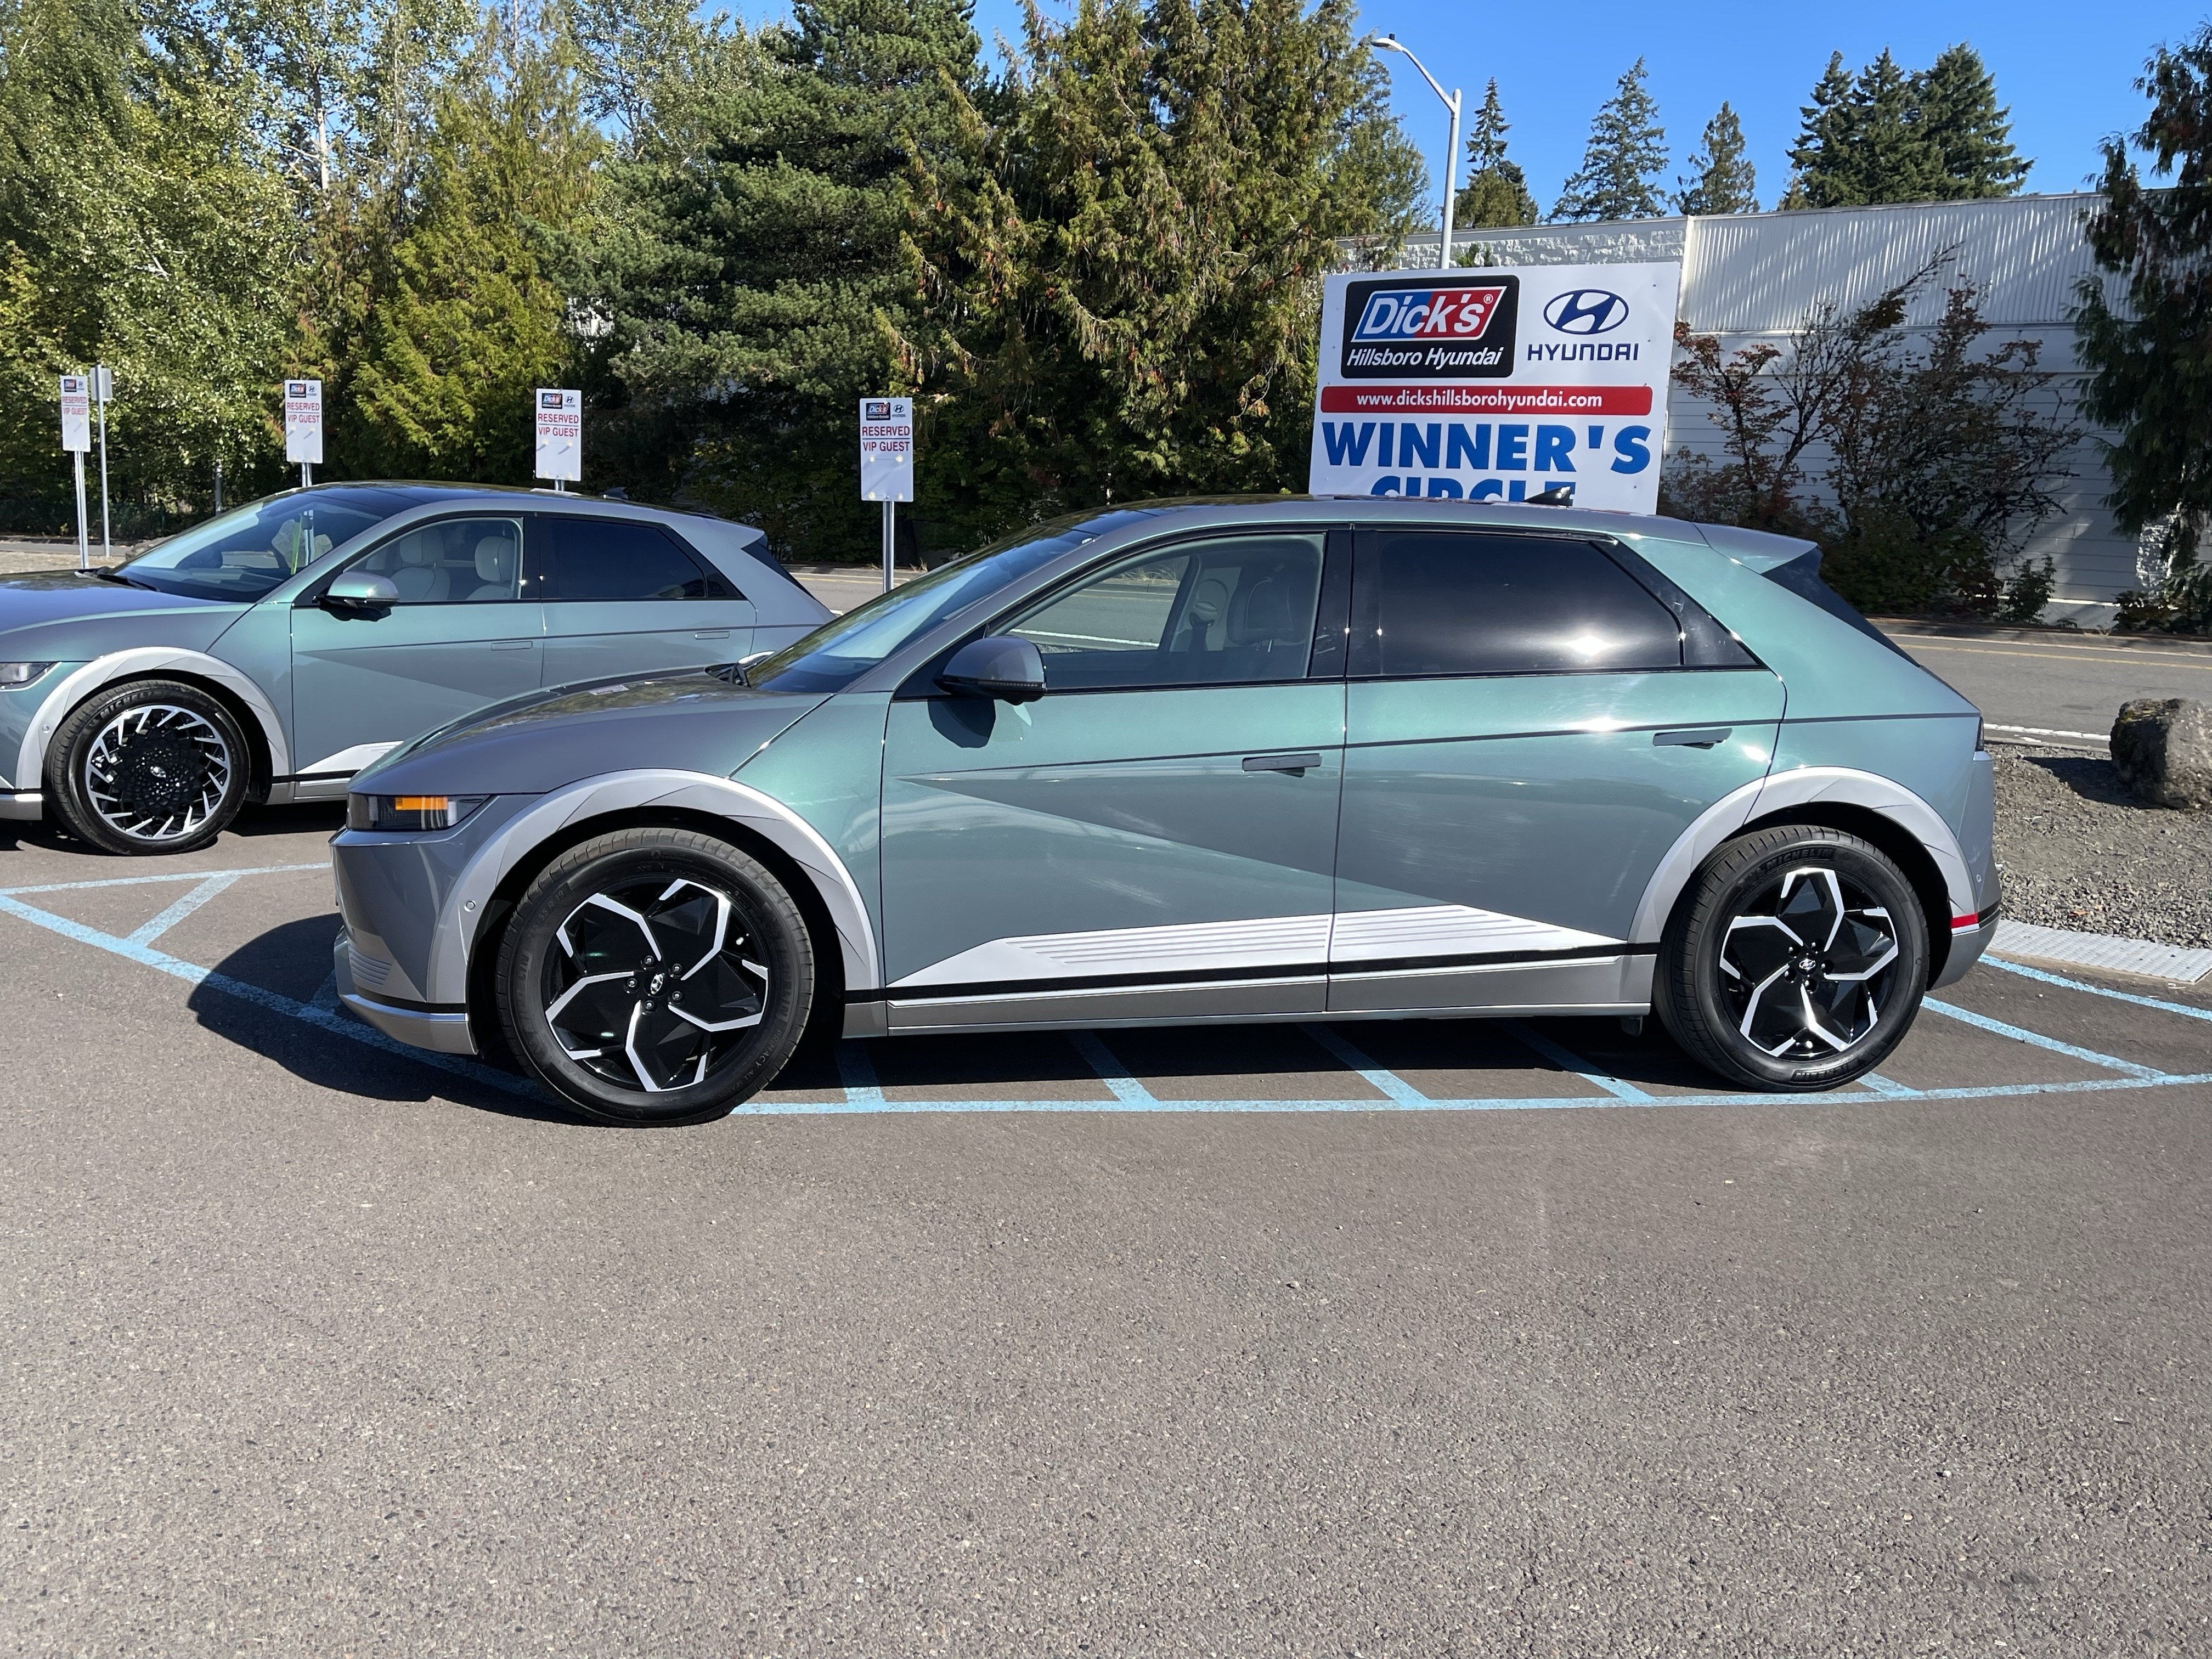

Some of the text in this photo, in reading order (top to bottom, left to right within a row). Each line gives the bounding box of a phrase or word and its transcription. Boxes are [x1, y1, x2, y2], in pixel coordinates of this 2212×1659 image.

[1362, 293, 1485, 334] Dick's
[1527, 343, 1639, 361] HYUNDAI
[1347, 346, 1505, 370] Hillsboro Hyundai
[1356, 389, 1603, 410] www.dickshillsborohyundai.com
[287, 402, 320, 411] RESERVED
[299, 415, 320, 423] GUEST
[538, 413, 579, 424] RESERVED
[538, 427, 579, 437] VIP GUEST
[862, 426, 910, 436] RESERVED
[863, 441, 910, 452] VIP GUEST
[1322, 422, 1651, 474] WINNER'S
